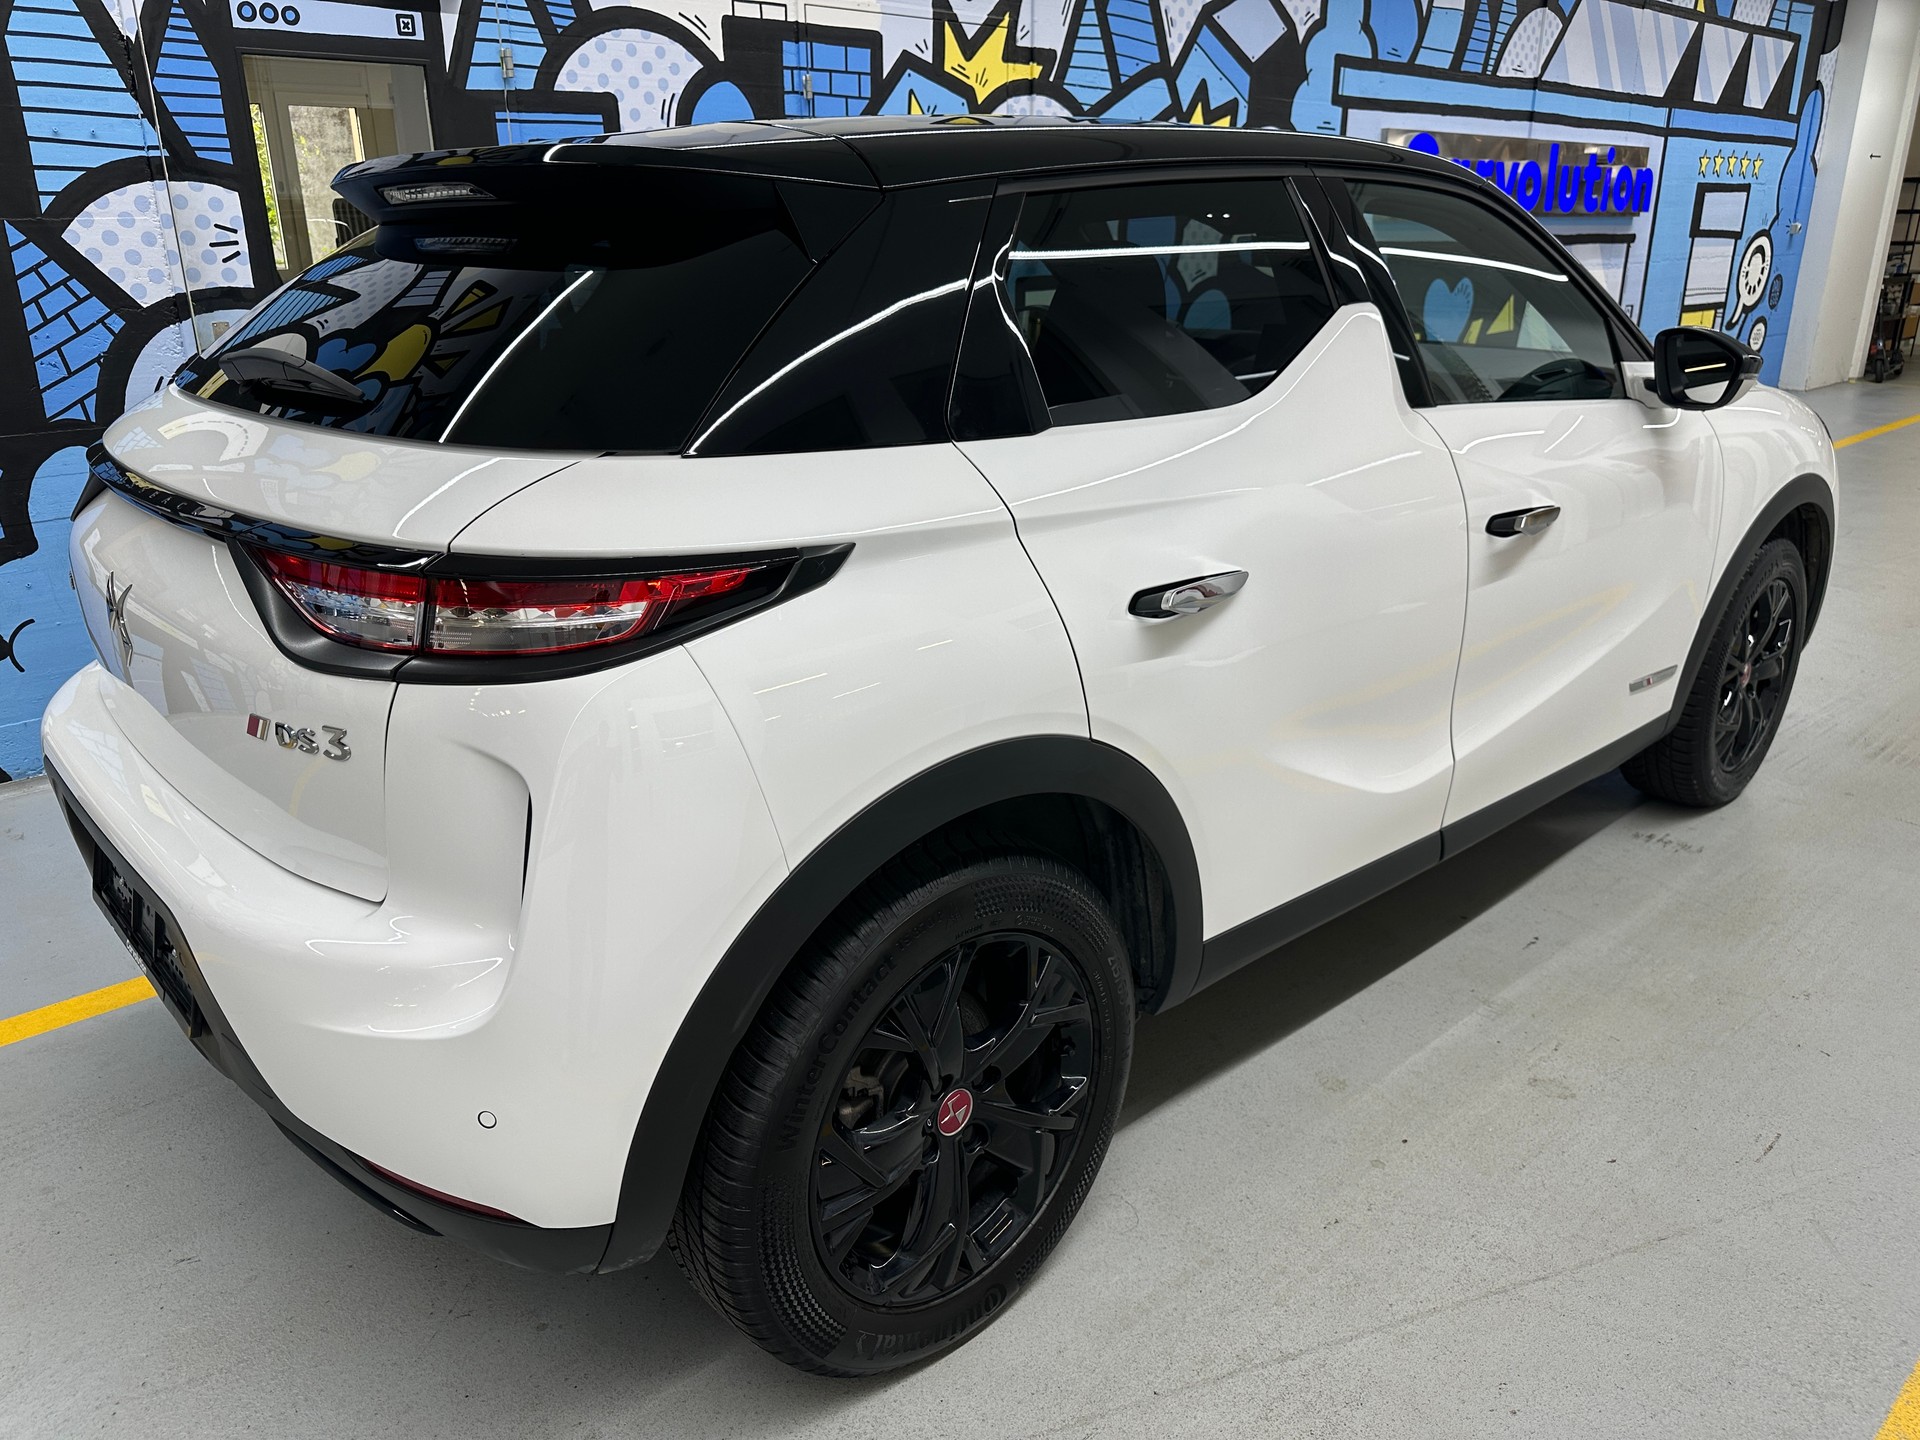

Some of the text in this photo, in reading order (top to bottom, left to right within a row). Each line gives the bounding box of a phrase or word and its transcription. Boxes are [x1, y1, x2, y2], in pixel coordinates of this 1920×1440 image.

[275, 721, 352, 762] DS 3
[776, 953, 898, 1152] WinterContact
[867, 1282, 1008, 1361] Continental
